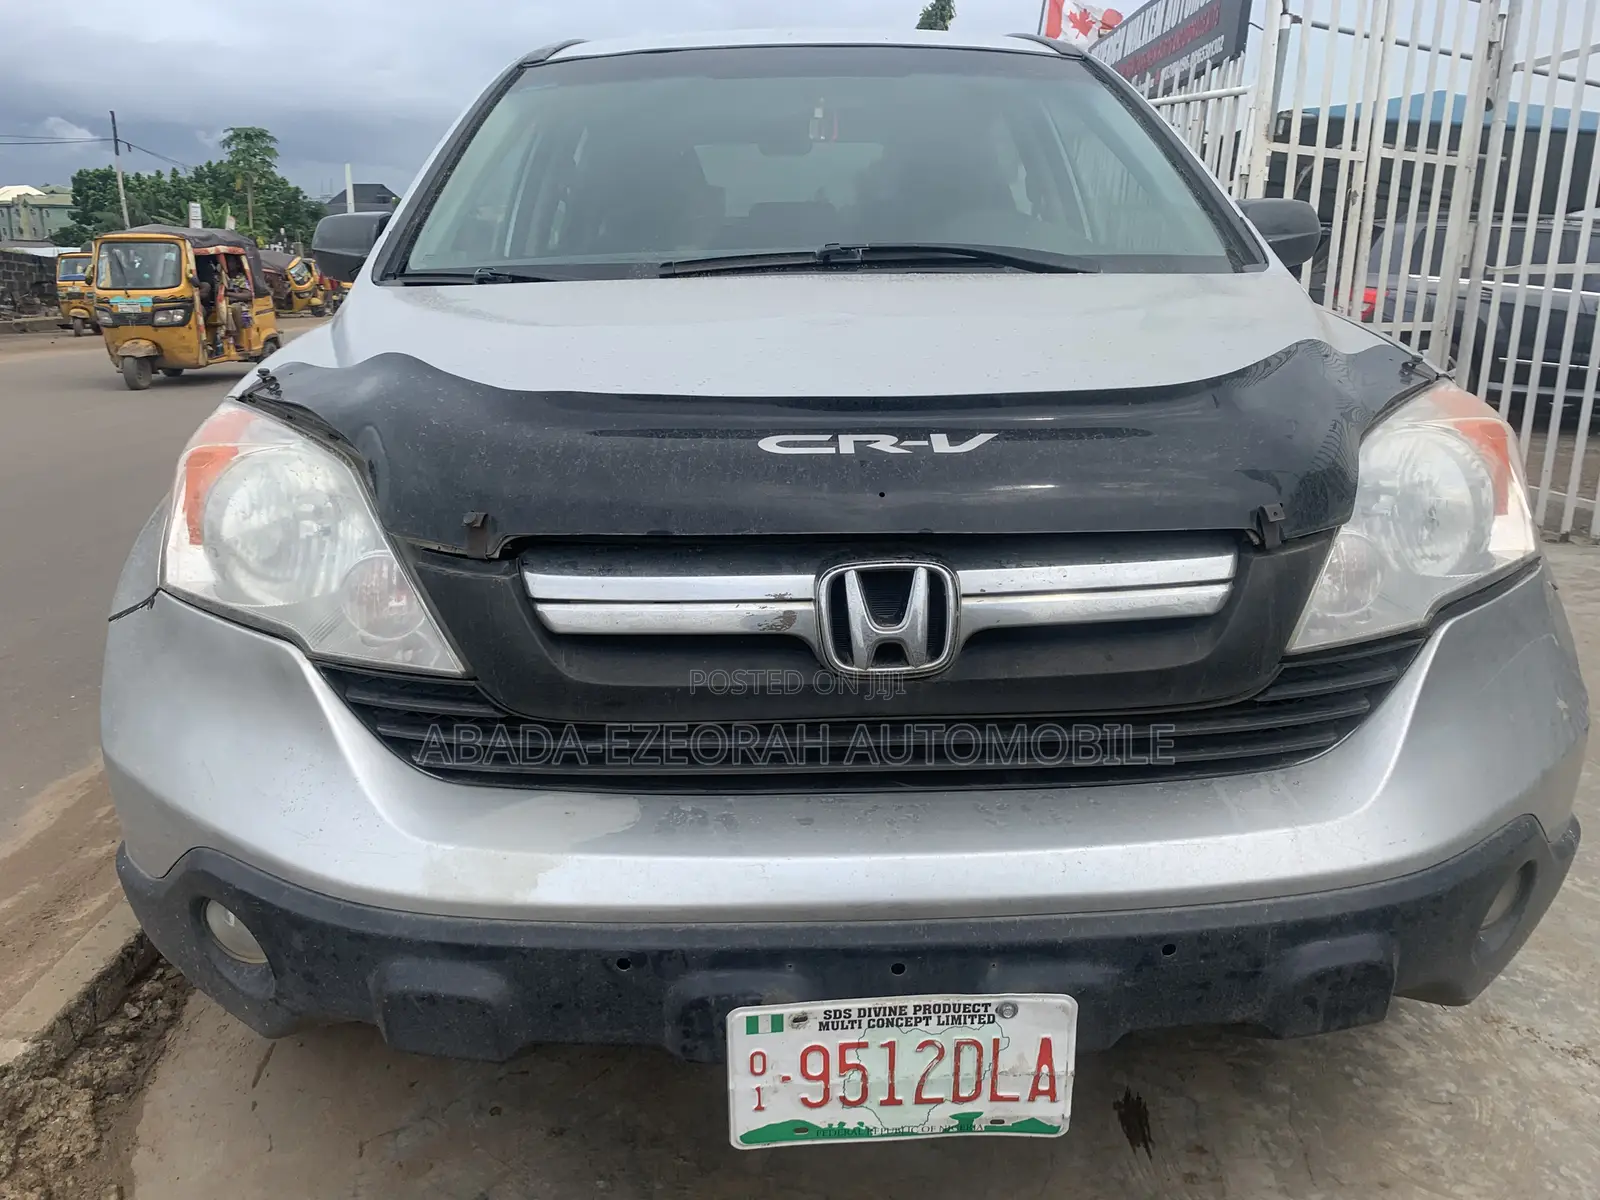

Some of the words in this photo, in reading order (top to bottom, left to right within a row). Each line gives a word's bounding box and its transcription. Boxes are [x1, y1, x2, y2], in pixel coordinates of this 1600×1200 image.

[757, 433, 999, 454] CR-V
[823, 1008, 852, 1020] SDS
[857, 1005, 908, 1018] DIVINE
[912, 1002, 992, 1016] PRODUECT
[818, 1020, 863, 1032] MULTI
[867, 1016, 933, 1029] CONCEPT
[936, 1013, 996, 1026] LIMITED
[921, 1124, 936, 1133] OF
